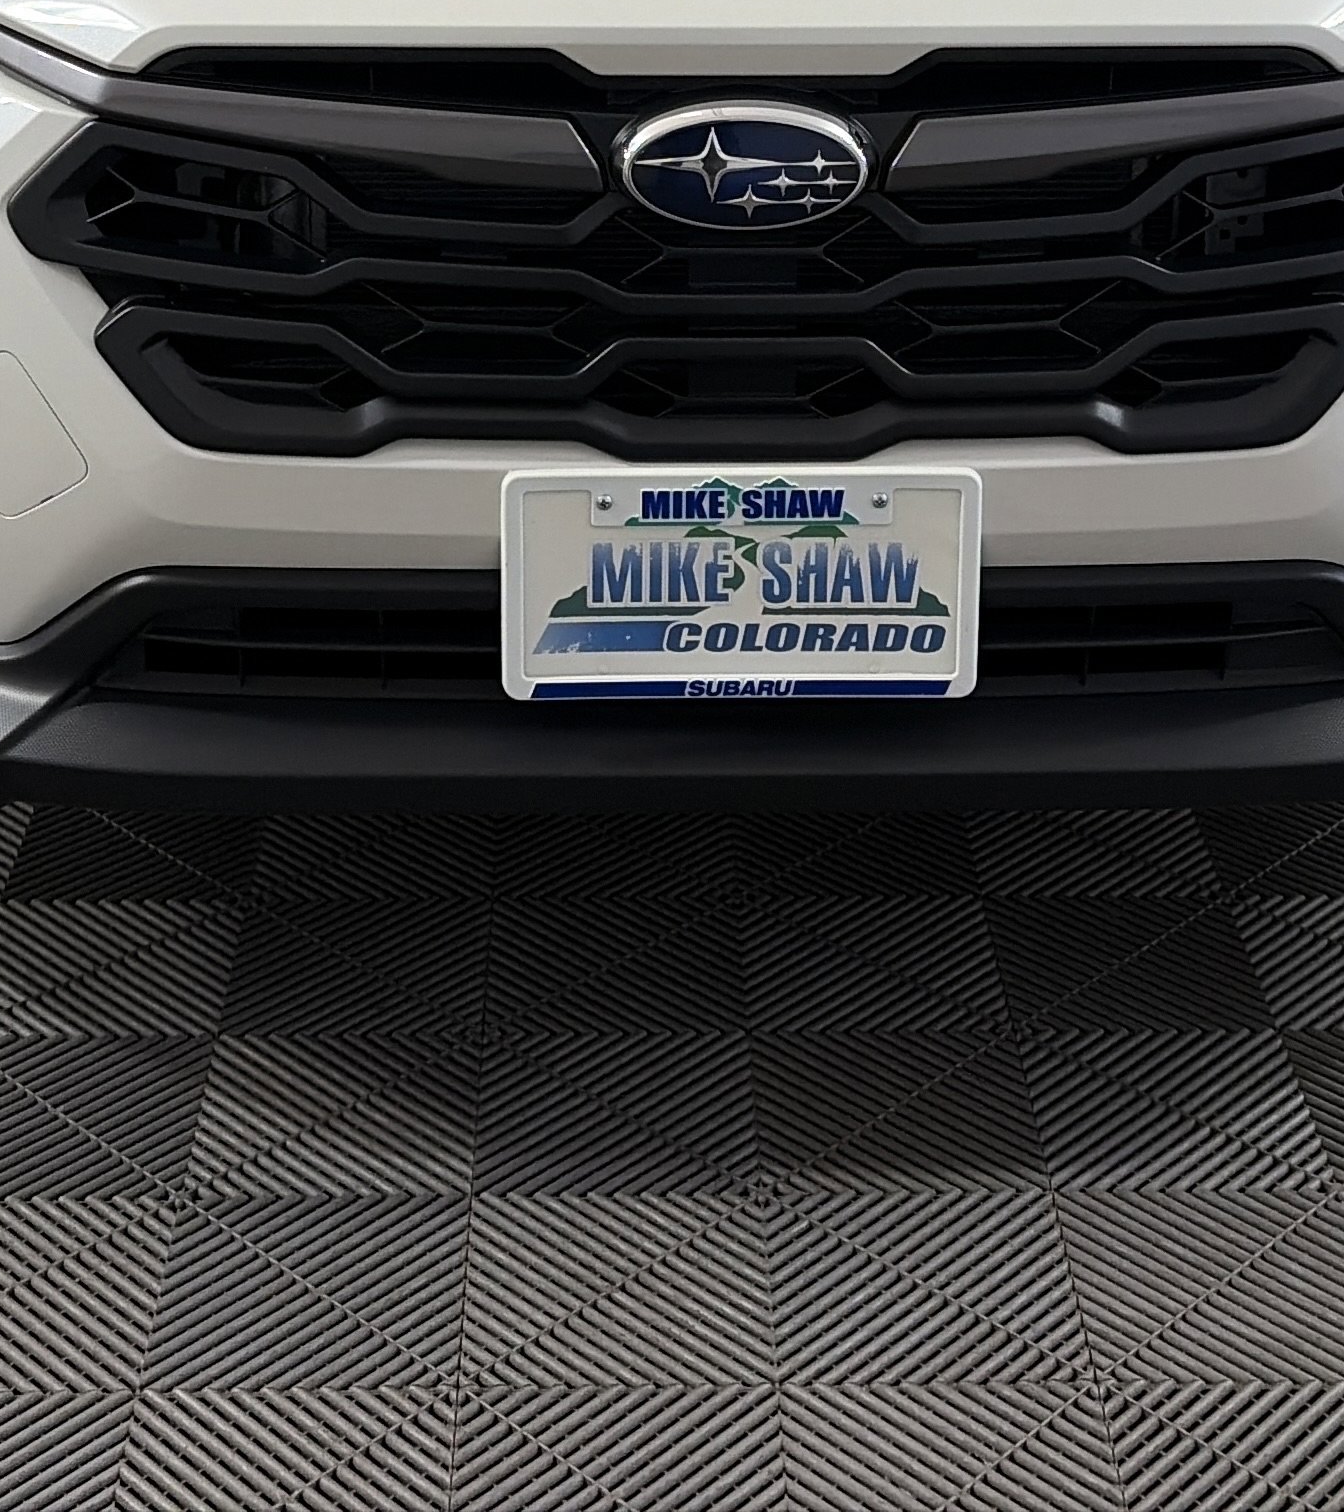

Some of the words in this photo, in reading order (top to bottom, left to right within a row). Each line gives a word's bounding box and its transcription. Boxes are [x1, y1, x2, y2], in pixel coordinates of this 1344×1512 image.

[641, 489, 725, 519] MIKE
[742, 489, 845, 519] SHAW
[592, 541, 731, 603] MIKE
[762, 541, 919, 603] SHAW
[666, 623, 946, 653] COLORADO
[687, 679, 793, 696] SUBARU
